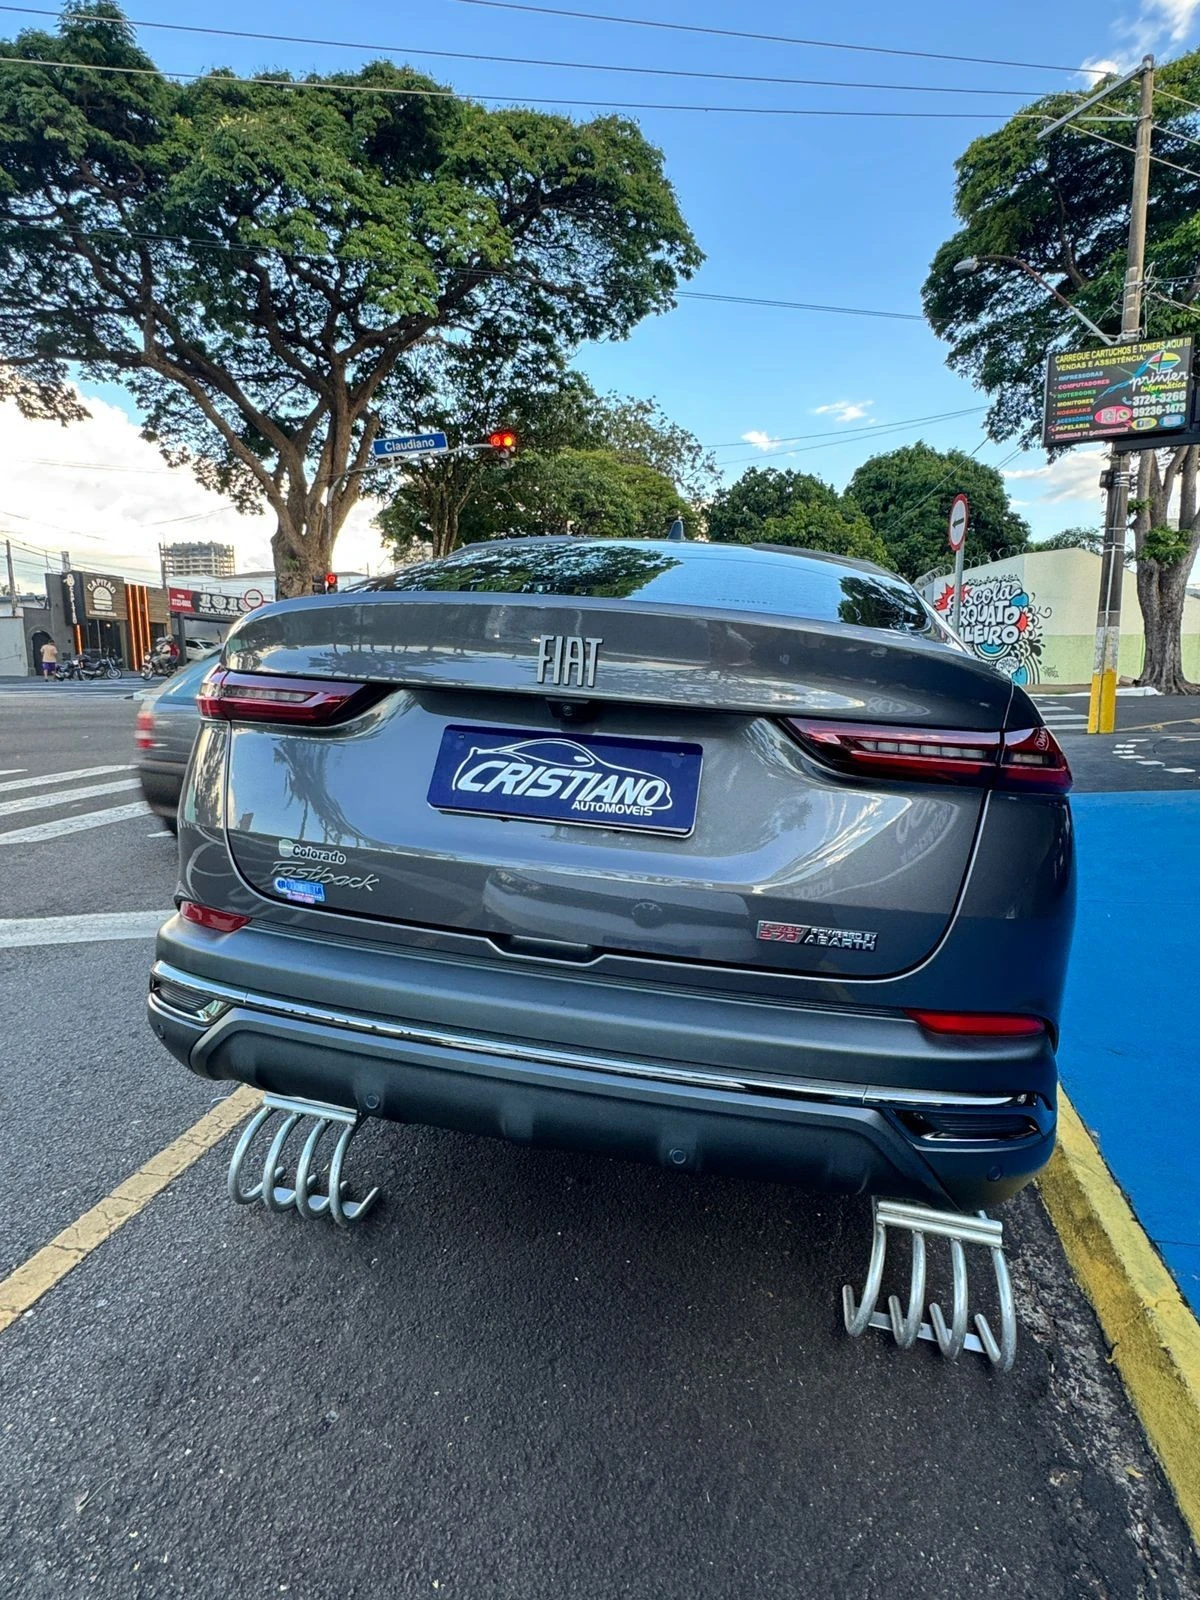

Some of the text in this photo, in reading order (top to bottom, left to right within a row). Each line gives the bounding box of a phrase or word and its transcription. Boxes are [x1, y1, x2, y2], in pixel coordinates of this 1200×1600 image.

[1055, 352, 1091, 364] CARREGUE
[1091, 346, 1131, 358] CARTUCHOS
[1132, 345, 1137, 353] E
[1139, 341, 1166, 352] TONERS
[1166, 339, 1183, 349] AQUI
[1056, 362, 1087, 371] VENDAS
[1058, 379, 1110, 390] COMPUTADORES
[1057, 389, 1097, 399] NOTEBOOKS
[1057, 398, 1094, 407] MONITORES
[1055, 423, 1090, 431] PAPELARIA
[384, 438, 435, 452] Claudiano
[537, 635, 603, 687] FIAT
[457, 760, 668, 806] CRISTIANO
[293, 845, 346, 864] Colorado
[270, 861, 380, 891] Fastback
[759, 930, 798, 943] 270
[804, 934, 876, 951] ABARTH
